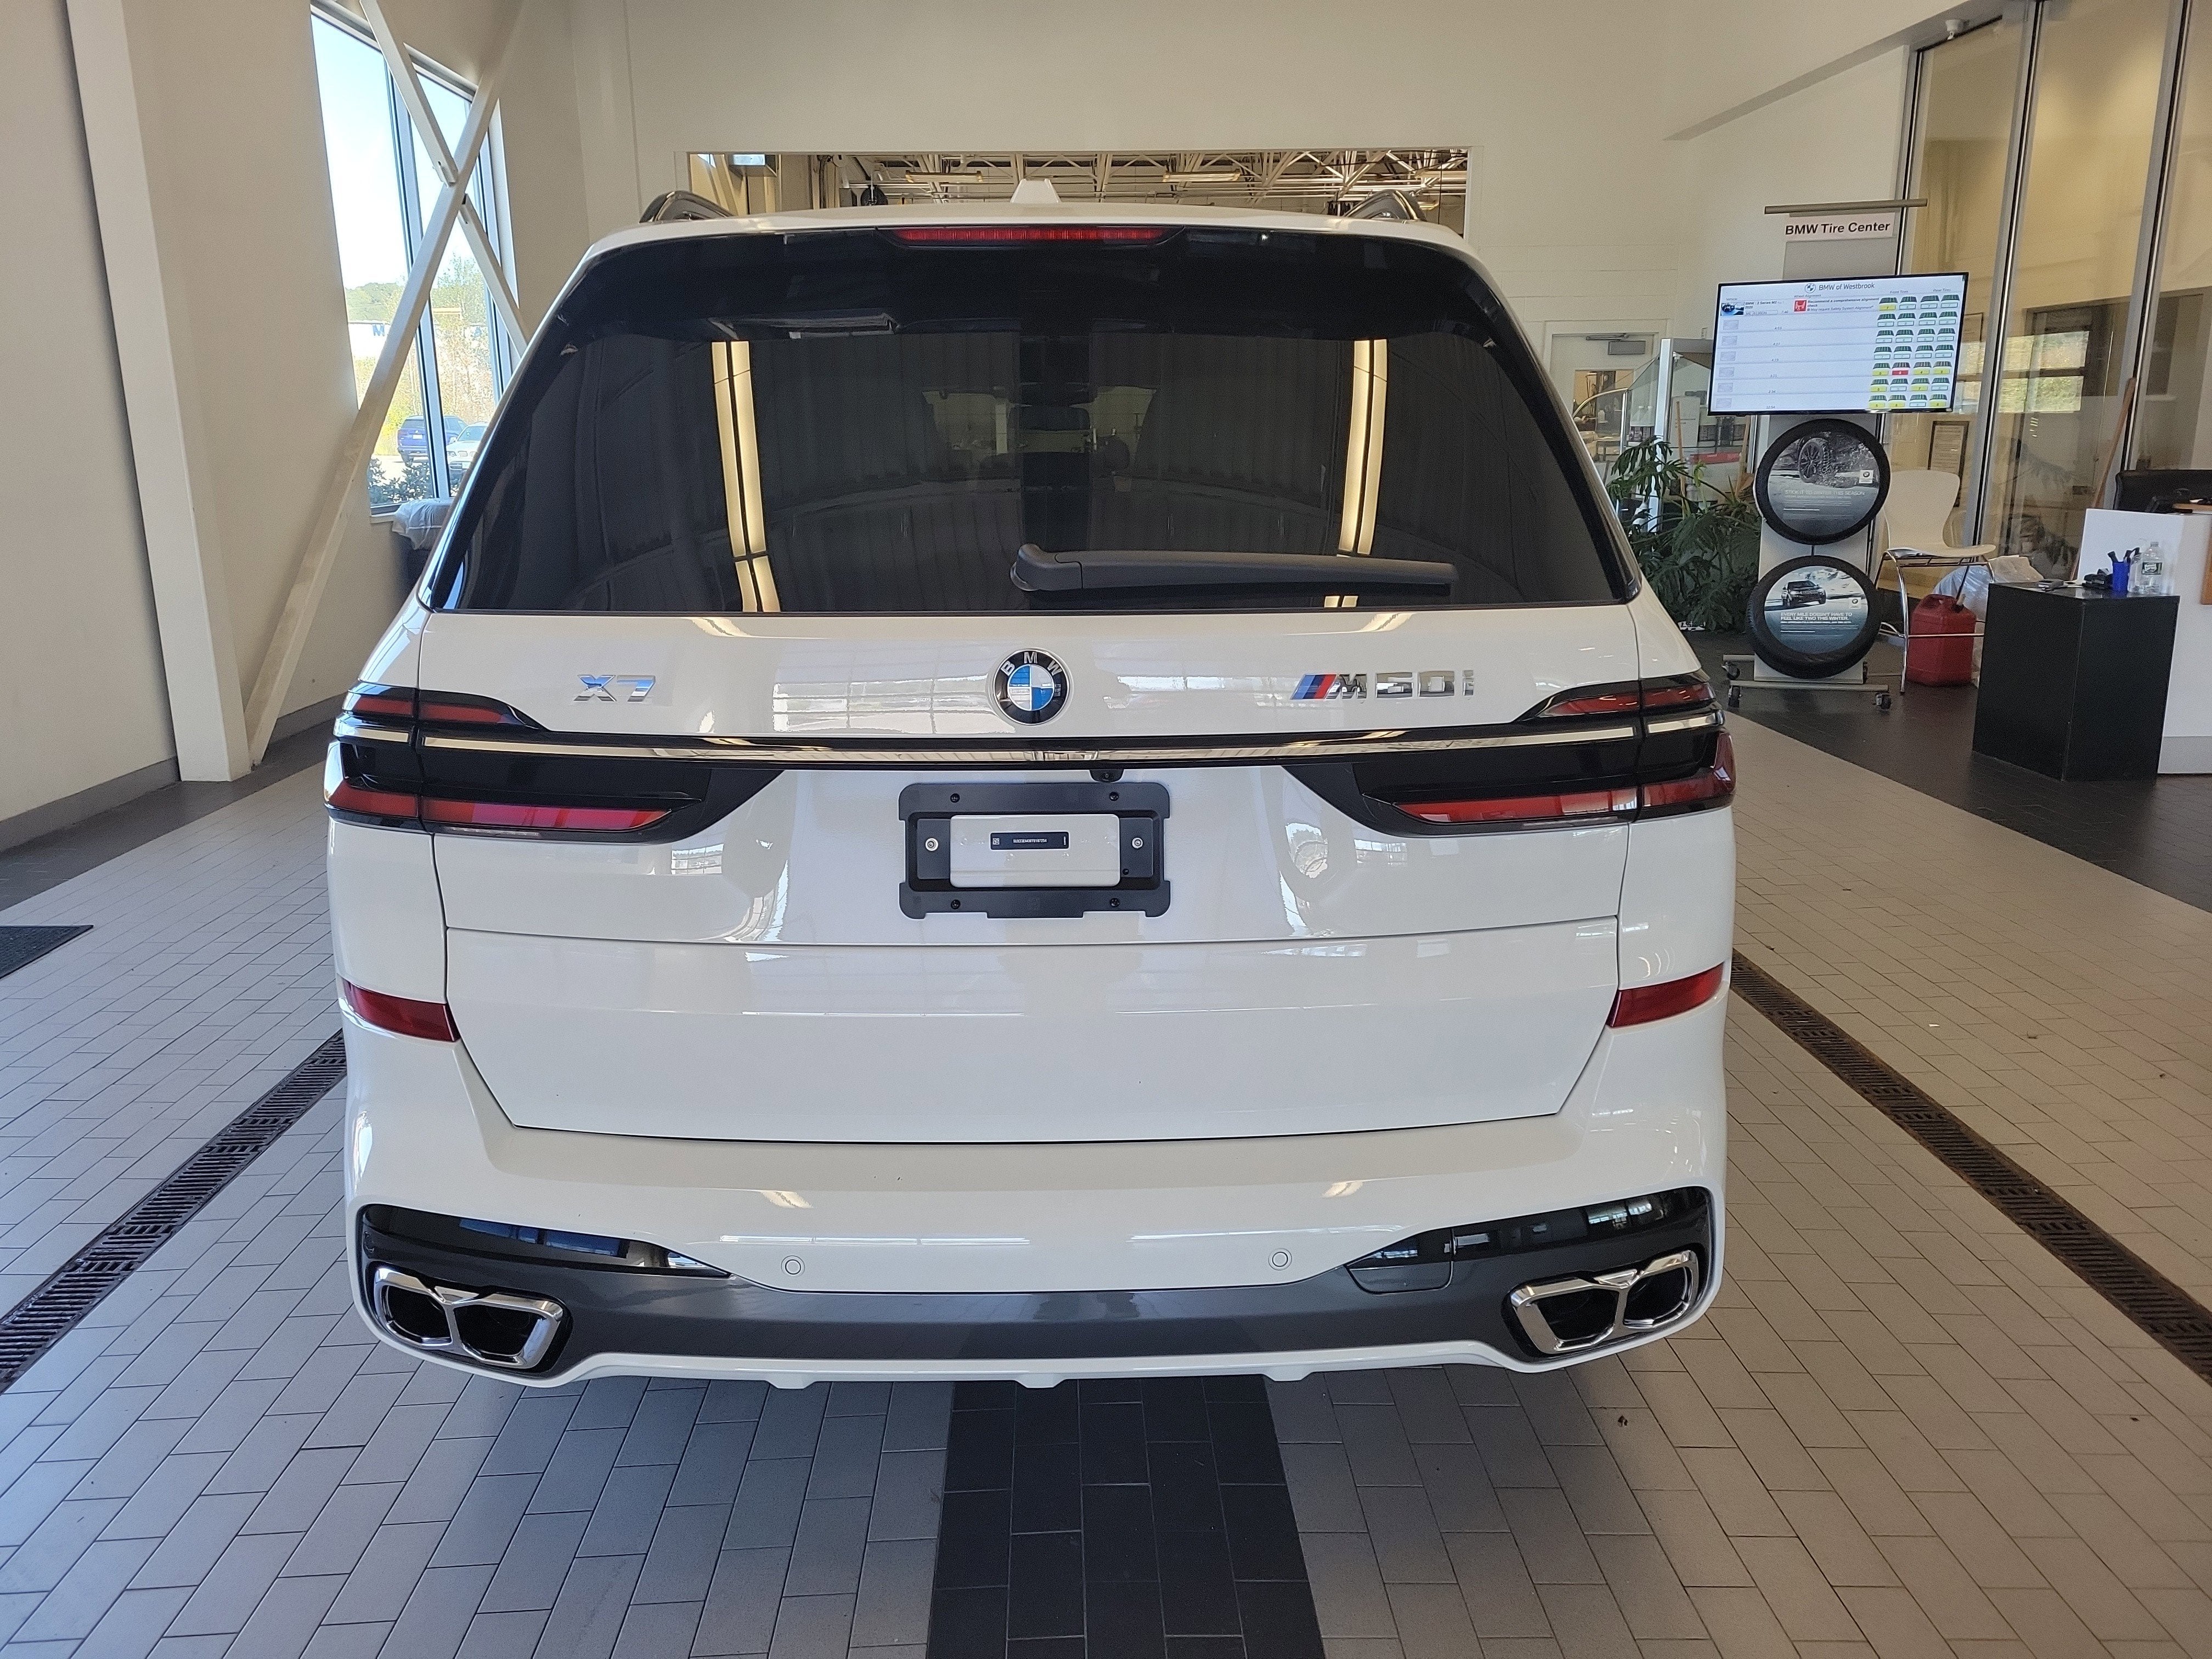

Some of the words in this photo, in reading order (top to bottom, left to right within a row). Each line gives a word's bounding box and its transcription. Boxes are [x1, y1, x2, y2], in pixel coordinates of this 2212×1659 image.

[1785, 224, 1819, 235] BMW
[1821, 223, 1844, 233] Tire
[1848, 222, 1891, 233] Center
[1000, 651, 1062, 676] BMW
[573, 674, 656, 702] X7
[1324, 669, 1474, 699] M60i
